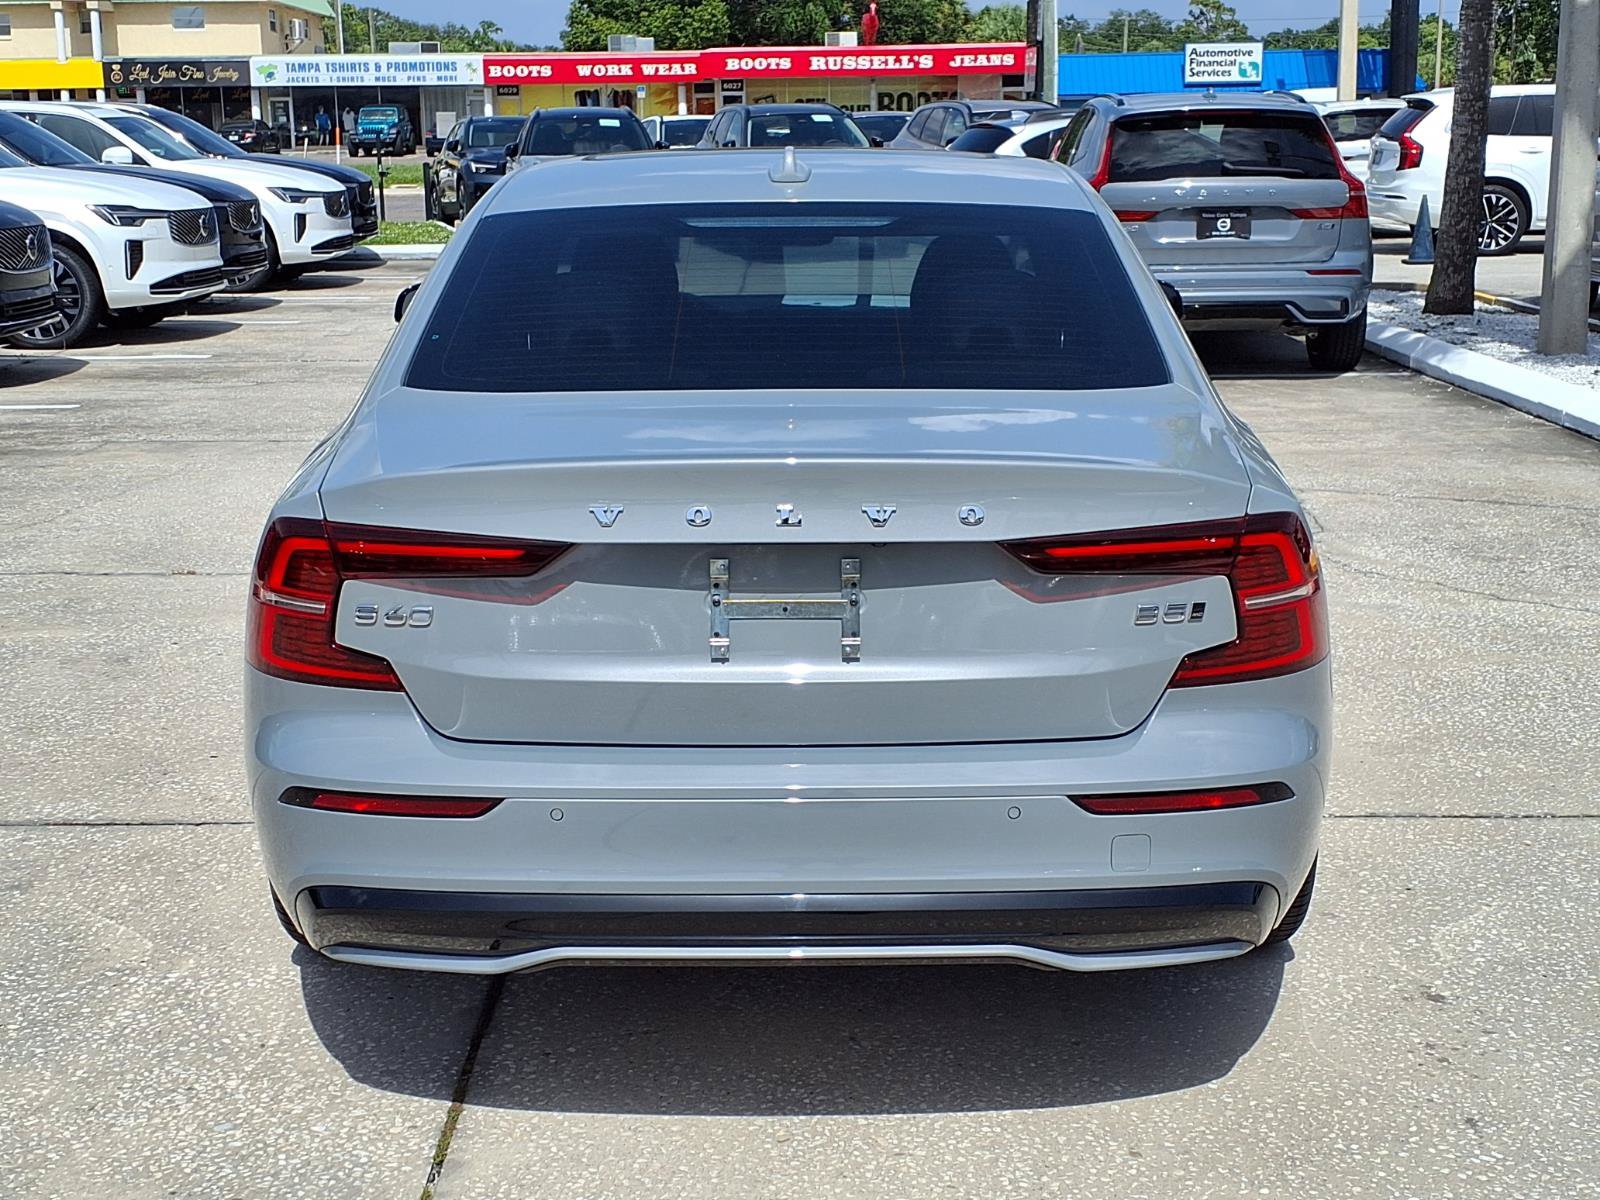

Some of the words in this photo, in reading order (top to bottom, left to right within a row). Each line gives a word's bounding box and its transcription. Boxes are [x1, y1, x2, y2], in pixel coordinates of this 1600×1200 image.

[1189, 48, 1253, 57] Automotive
[725, 57, 792, 71] BOOTS
[809, 54, 934, 70] RUSSELL'S
[949, 53, 1015, 67] JEANS
[1189, 58, 1236, 67] Financial
[285, 62, 321, 73] TAMPA
[325, 62, 370, 73] TSHIRTS
[374, 62, 382, 72] &
[386, 61, 458, 72] PROMOTIONS
[488, 65, 553, 78] BOOTS
[576, 64, 633, 77] WORK
[641, 63, 698, 75] WEAR
[1189, 67, 1232, 77] Services
[723, 81, 742, 90] 6027
[588, 504, 985, 528] VOLVO
[354, 604, 433, 627] S60
